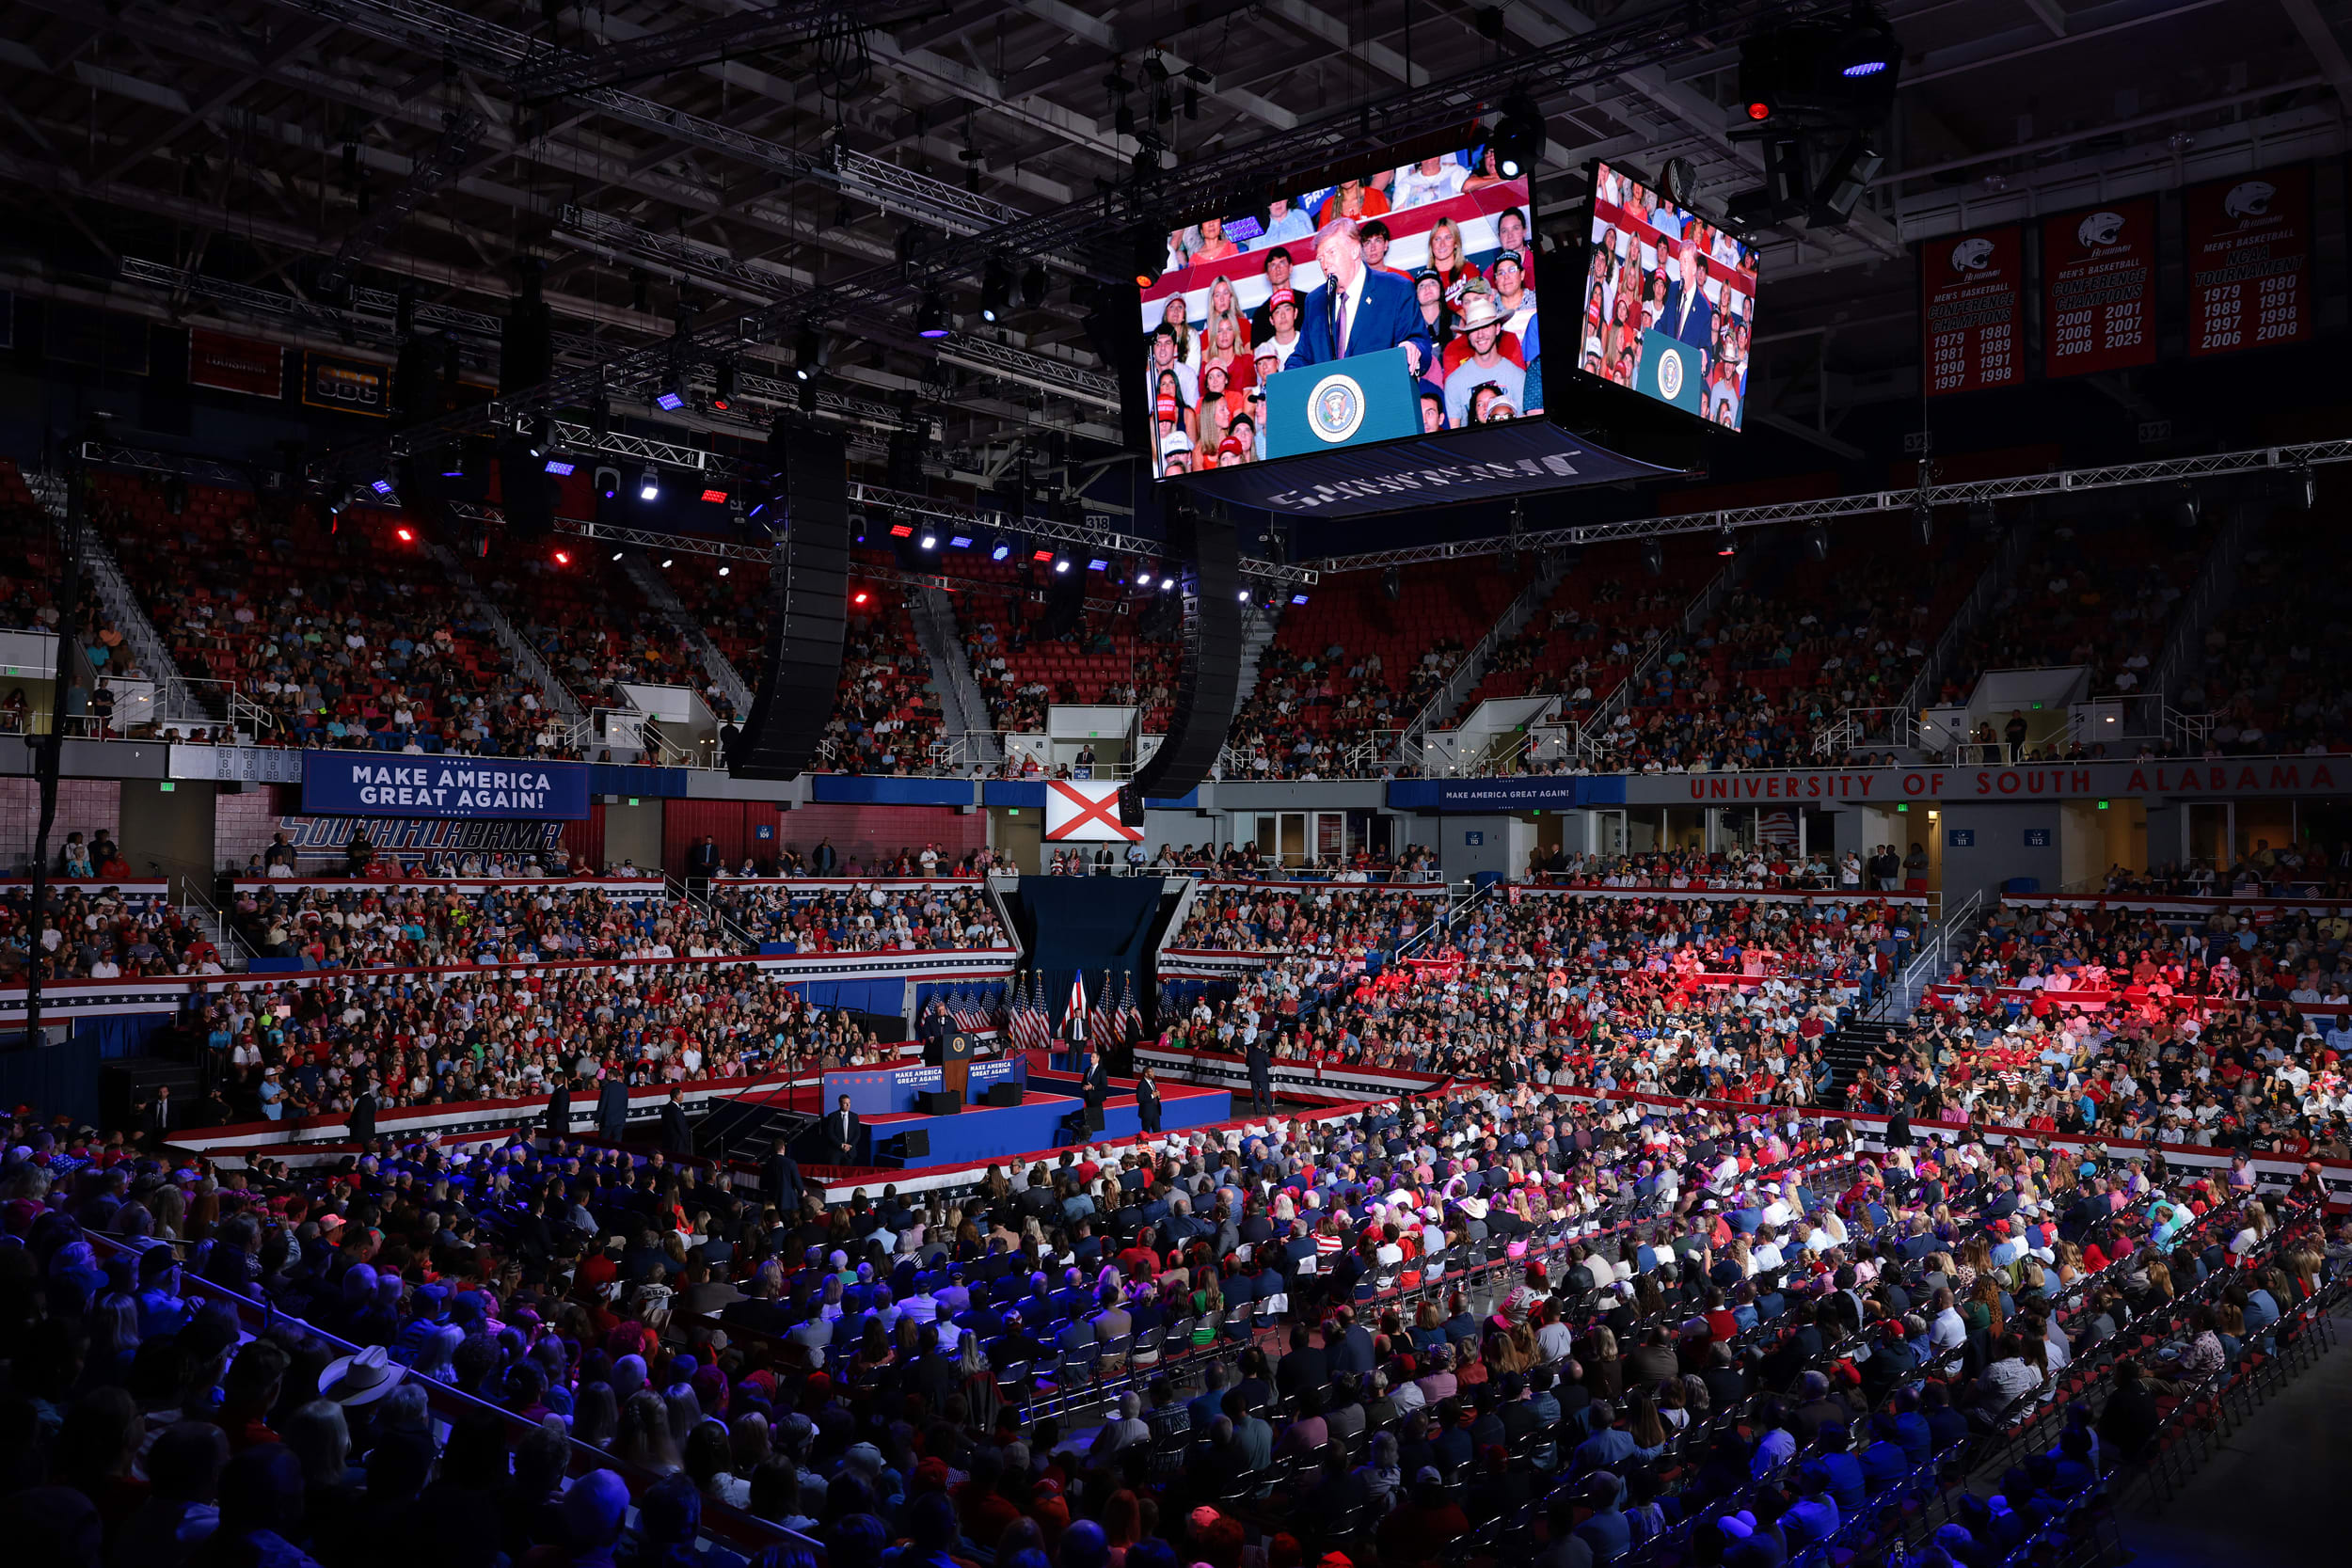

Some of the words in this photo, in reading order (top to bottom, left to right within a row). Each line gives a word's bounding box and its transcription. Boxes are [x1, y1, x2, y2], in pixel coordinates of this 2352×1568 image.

[2203, 241, 2233, 253] MEN'S
[2236, 228, 2296, 247] BASKETBALL
[2227, 245, 2270, 265] NCAA
[2058, 267, 2084, 279] MEN'S
[2088, 258, 2139, 275] BASKETBALL
[2195, 255, 2305, 286] TOURNAMENT
[1934, 291, 1958, 303] MEN'S
[1961, 282, 2010, 298] BASKETBALL
[2052, 268, 2147, 296] CONFERENCE
[2203, 285, 2241, 302] 1979
[2259, 275, 2296, 293] 1980
[1929, 292, 2015, 319] CONFERENCE
[2056, 285, 2143, 310] CHAMPIONS
[2204, 300, 2241, 317] 1989
[2259, 291, 2296, 309] 1991
[1932, 309, 2011, 333] CHAMPIONS
[2056, 310, 2092, 326] 2000
[2106, 301, 2141, 319] 2001
[2204, 315, 2242, 333] 1997
[2259, 306, 2297, 325] 1998
[1934, 332, 1964, 348] 1979
[1979, 325, 2011, 341] 1980
[2056, 325, 2092, 341] 2006
[2106, 316, 2142, 334] 2007
[2201, 331, 2242, 349] 2006
[2256, 322, 2297, 341] 2008
[1934, 346, 1964, 361] 1981
[1979, 339, 2011, 355] 1989
[2056, 340, 2092, 356] 2008
[2105, 331, 2142, 349] 2025
[1934, 359, 1964, 375] 1990
[1979, 353, 2010, 369] 1991
[1934, 374, 1964, 390] 1997
[1979, 367, 2011, 383] 1998
[2141, 423, 2169, 441] 322
[1087, 517, 1108, 529] 318
[352, 766, 428, 786] MAKE
[437, 769, 551, 791] AMERICA
[1691, 775, 1874, 799] UNIVERSITY
[1902, 773, 1945, 796] OF
[1977, 769, 2090, 795] SOUTH
[2127, 764, 2335, 792] ALABAMA
[359, 786, 448, 805] GREAT
[456, 790, 545, 809] AGAIN!
[914, 1069, 943, 1077] AMERICA
